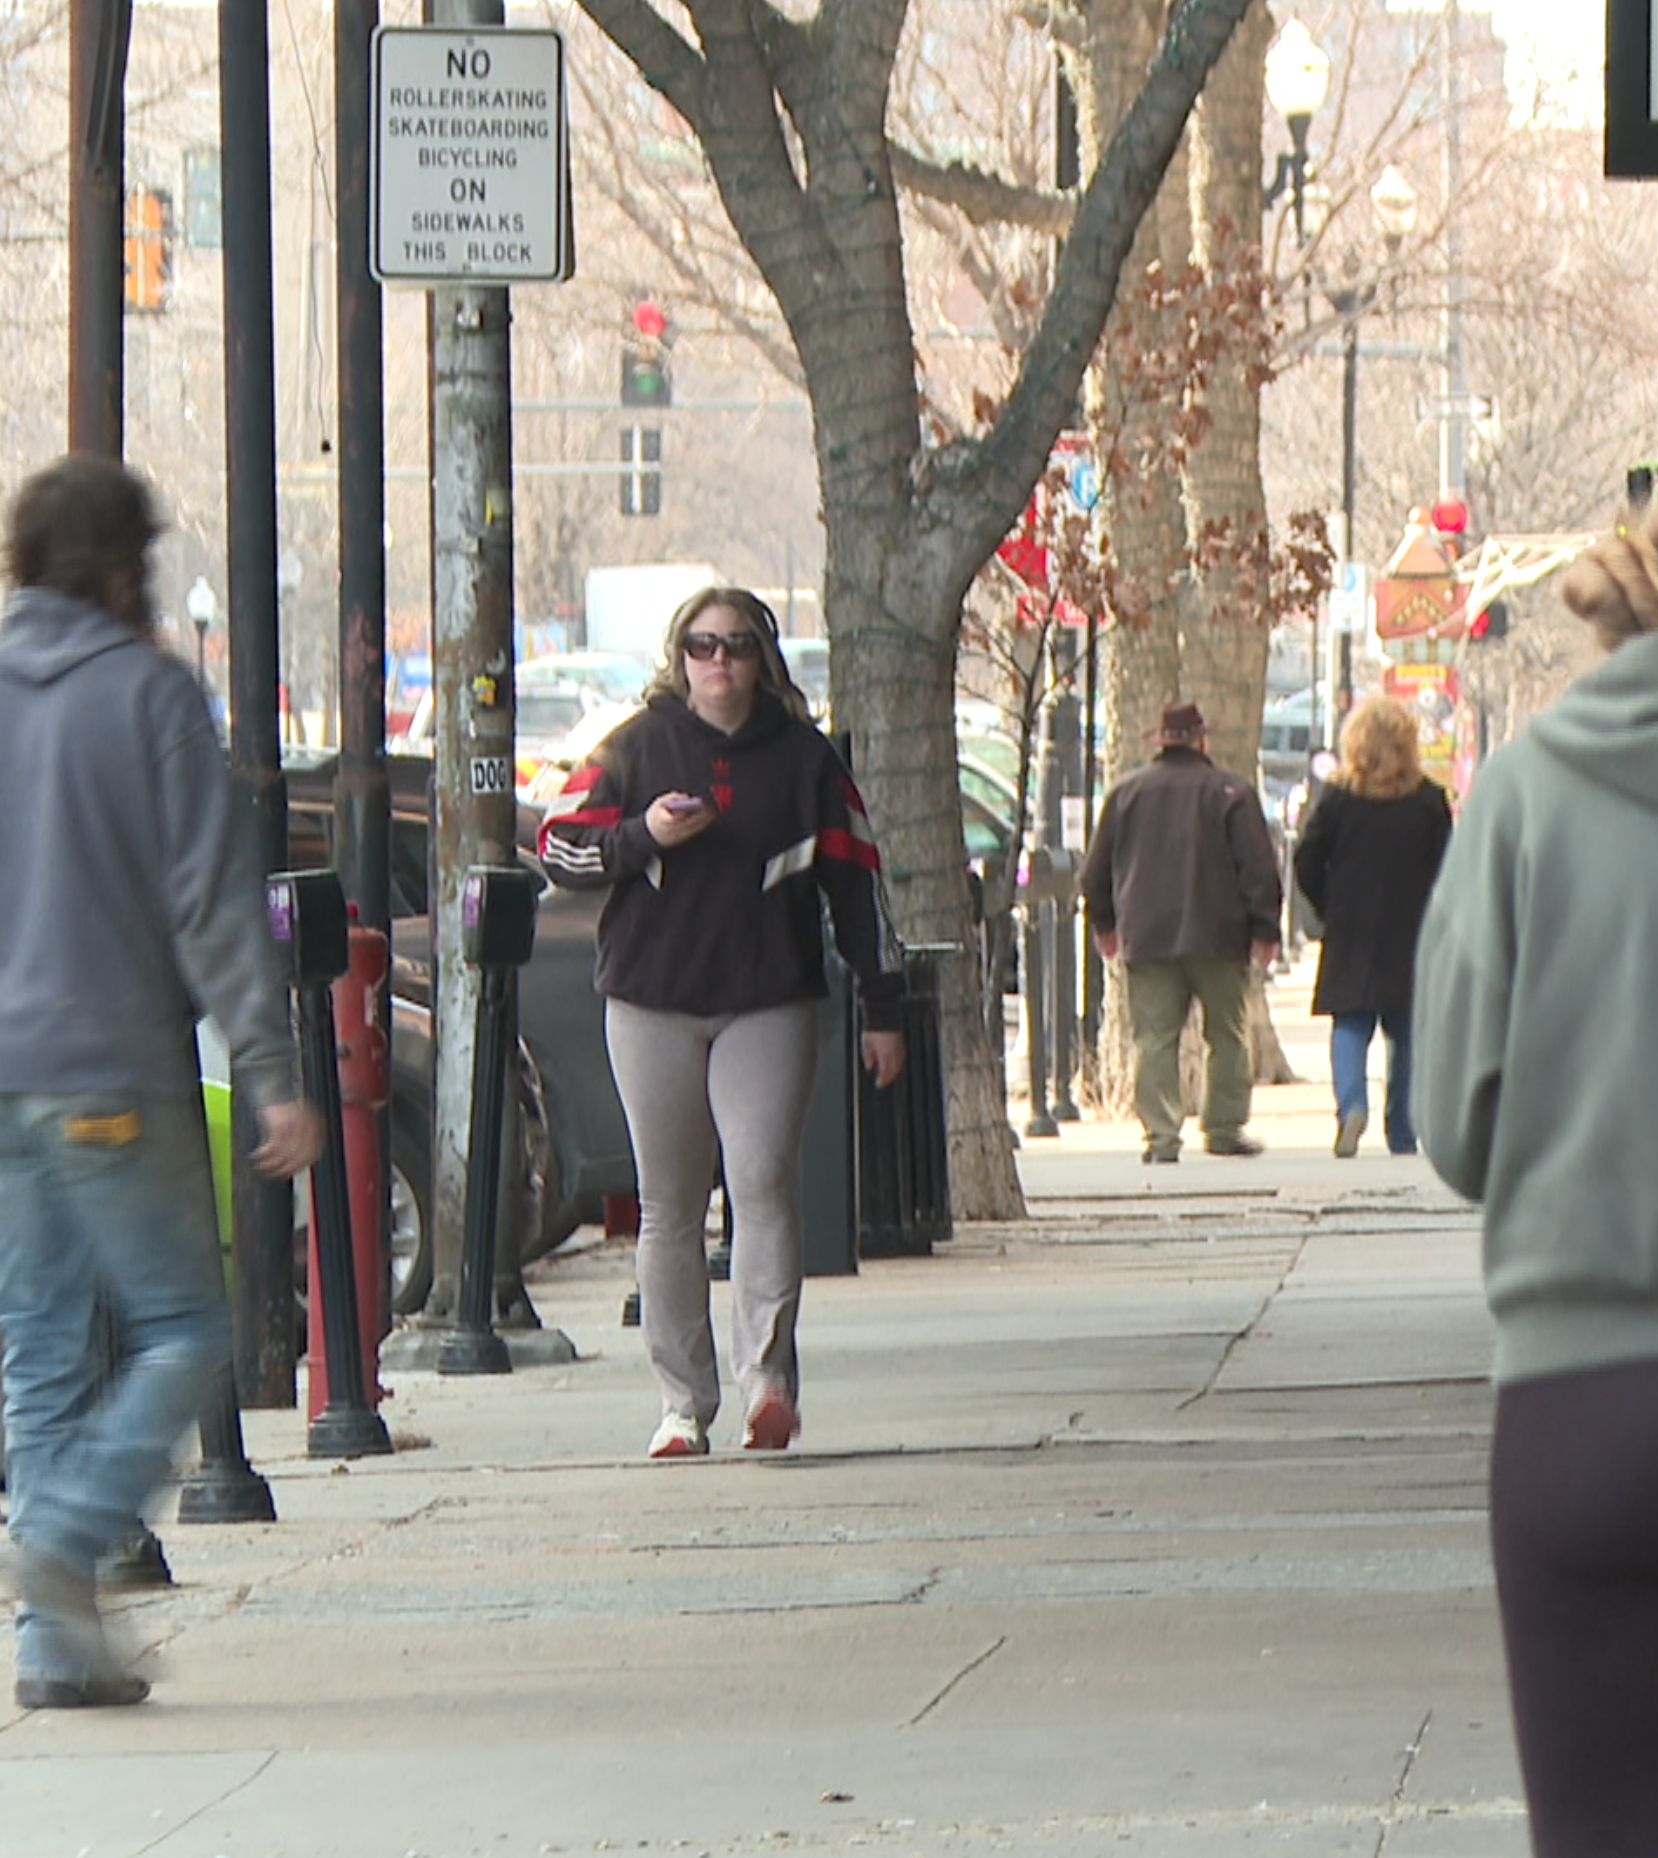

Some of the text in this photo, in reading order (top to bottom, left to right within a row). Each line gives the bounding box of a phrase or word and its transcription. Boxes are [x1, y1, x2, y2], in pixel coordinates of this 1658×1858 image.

[446, 48, 492, 79] NO
[389, 87, 548, 109] ROLLERSKATING
[388, 118, 549, 139] SKATEBOARDING
[418, 147, 518, 168] BICYCLING
[450, 177, 487, 203] ON
[411, 212, 525, 233] SIDEWALKS
[403, 242, 532, 262] THIS BLOCK
[474, 760, 506, 790] DOG
